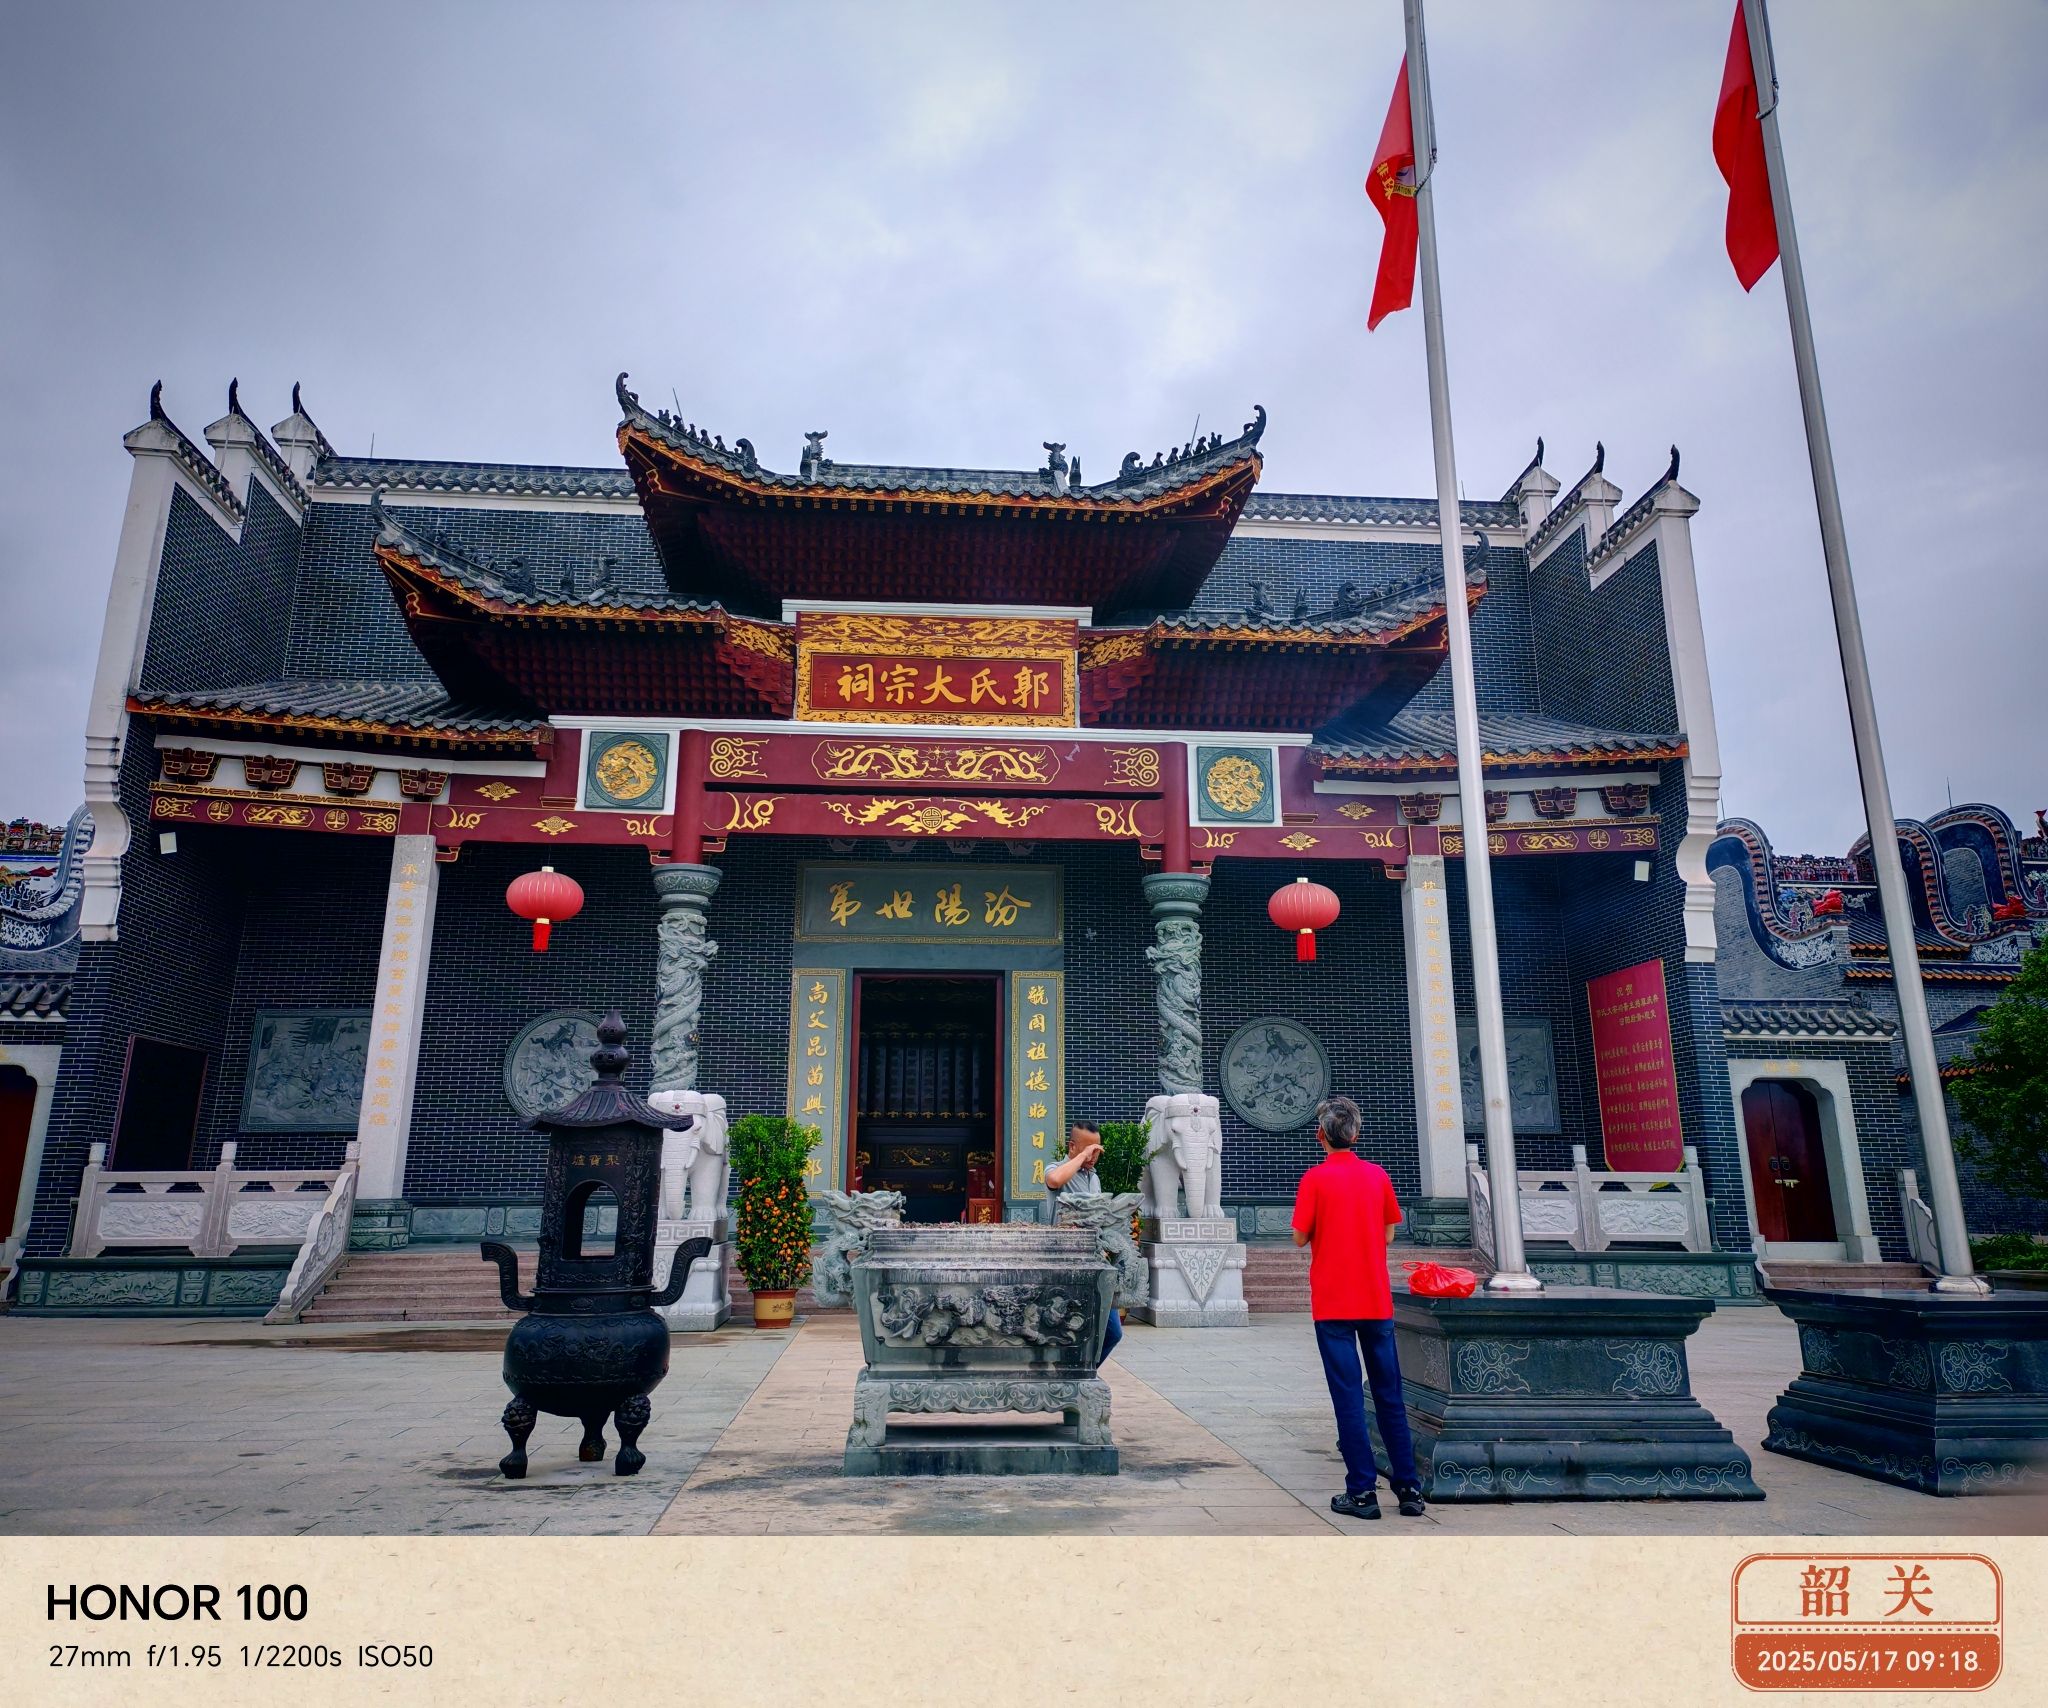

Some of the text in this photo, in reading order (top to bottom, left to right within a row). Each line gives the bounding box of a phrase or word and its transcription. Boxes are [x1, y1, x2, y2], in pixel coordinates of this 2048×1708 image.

[837, 663, 1050, 710] 郭氏大宗祠
